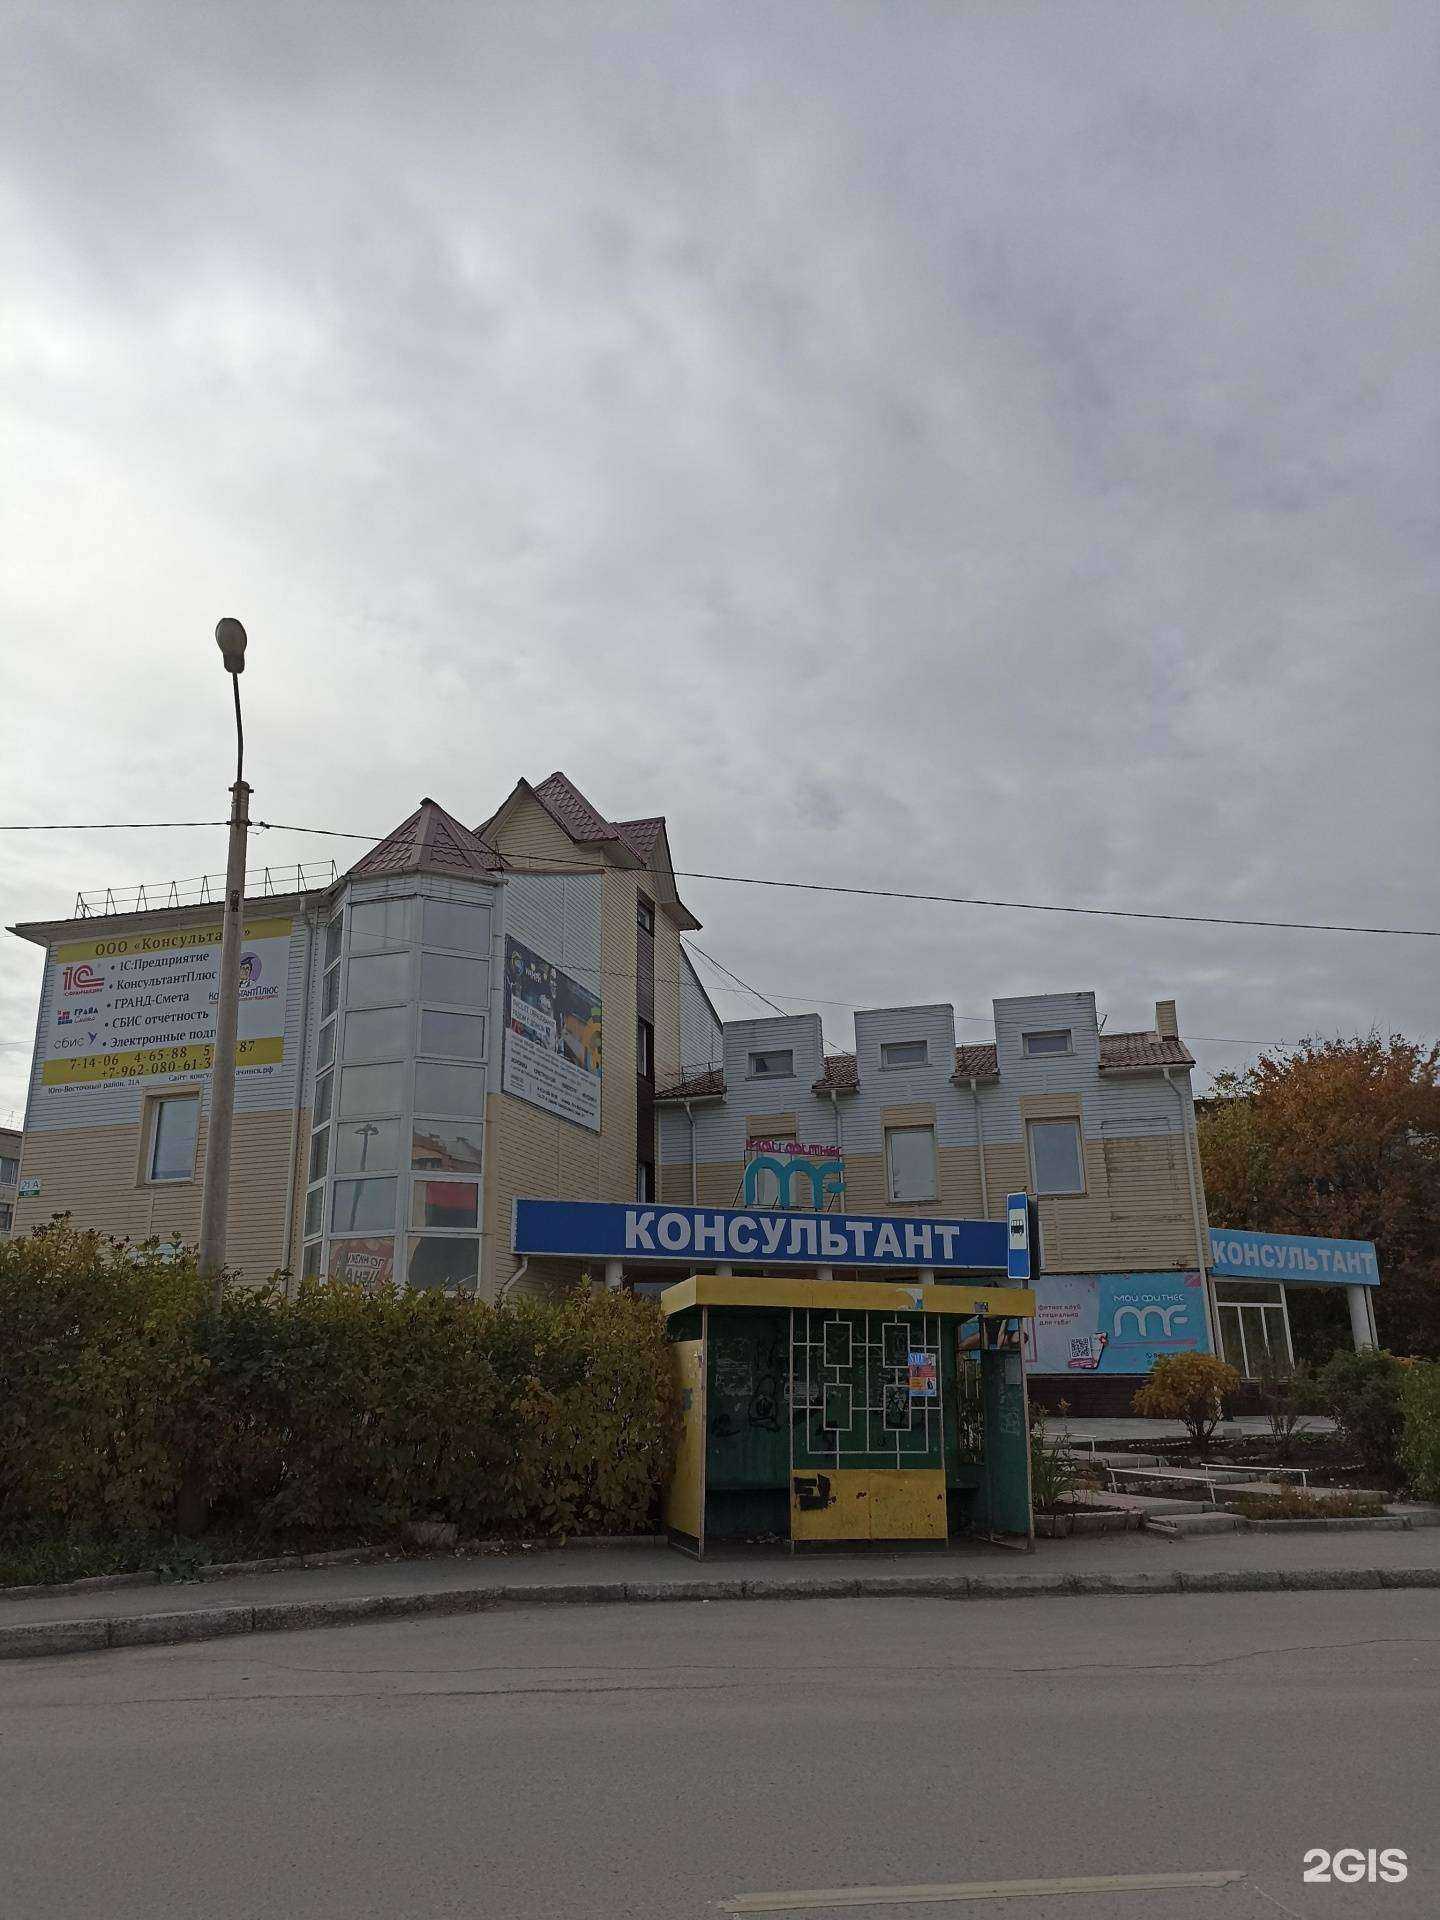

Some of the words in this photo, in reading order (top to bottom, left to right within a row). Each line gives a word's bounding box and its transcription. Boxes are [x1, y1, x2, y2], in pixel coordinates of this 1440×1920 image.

[95, 940, 128, 956] ООО
[134, 928, 250, 950] «Консульта»
[120, 951, 210, 971] 1С:Предприятие
[117, 971, 217, 990] КонсультантПлюс
[114, 992, 189, 1009] ГРАНД-Смета
[112, 1015, 142, 1029] СБИС
[145, 1012, 209, 1025] отчётность
[110, 1031, 186, 1048] Электронные
[189, 1028, 217, 1041] подп
[70, 1055, 119, 1070] 7-14-06
[134, 1047, 187, 1063] 4-65-88
[102, 1057, 212, 1078] +7-962-080-61-3
[625, 1210, 960, 1259] КОНСУЛЬТАНТ
[1211, 1239, 1374, 1275] КОНСУЛЬТАНТ
